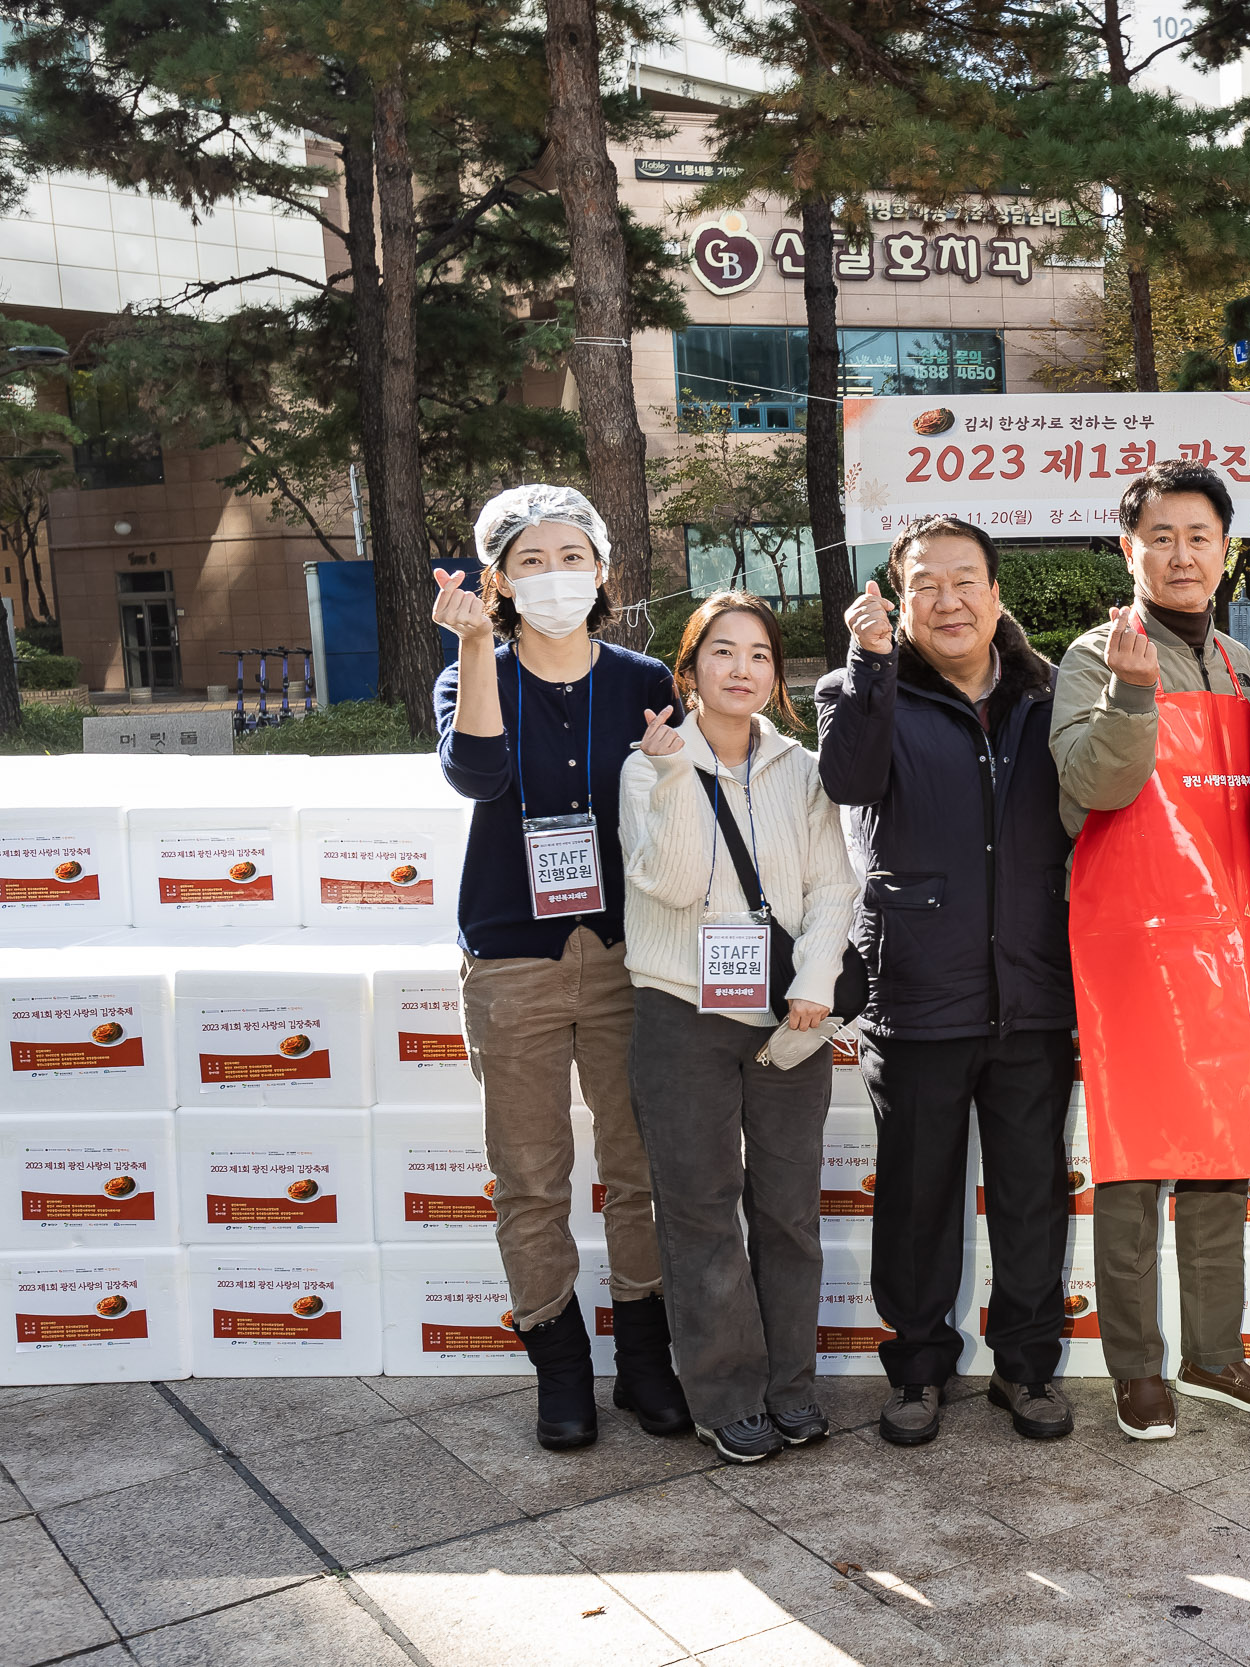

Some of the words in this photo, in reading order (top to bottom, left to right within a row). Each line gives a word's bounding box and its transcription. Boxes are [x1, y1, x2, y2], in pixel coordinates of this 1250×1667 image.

[956, 350, 981, 364] 문의
[915, 365, 948, 379] 1688
[957, 367, 995, 380] 4650
[964, 416, 993, 432] 김치
[999, 415, 1064, 431] 한상자로
[1069, 415, 1117, 430] 전하는
[1123, 415, 1155, 430] 안부
[905, 444, 1026, 483] 2023
[1040, 439, 1156, 483] 제1회
[880, 515, 892, 531] 일
[897, 513, 909, 527] 시
[967, 512, 987, 525] 11.
[991, 509, 1033, 525] 20(월)
[1050, 509, 1064, 524] 장
[1068, 510, 1083, 522] 소
[120, 731, 198, 747] 머릿돌
[1182, 775, 1202, 787] 광진
[1203, 775, 1227, 786] 사랑의
[3, 850, 20, 858] 제1회
[23, 849, 36, 858] 광진
[39, 848, 60, 857] 사랑의
[63, 847, 91, 856] 김장축제
[197, 850, 211, 858] 광진
[213, 849, 234, 857] 사랑의
[236, 849, 264, 857] 김장축제
[539, 850, 588, 868] STAFF
[538, 865, 592, 883] 진행요원
[548, 892, 588, 903] 광진복지재단
[711, 946, 760, 959] STAFF
[708, 961, 761, 975] 진행요원
[715, 988, 754, 996] 광진복지재단
[402, 1002, 419, 1011] 2023
[421, 1002, 440, 1011] 제1회
[443, 1001, 459, 1010] 광진
[31, 1011, 52, 1019] 제1회
[54, 1009, 71, 1019] 광진
[73, 1009, 98, 1018] 사랑의
[100, 1007, 133, 1017] 김장축제
[221, 1023, 241, 1031] 제1회
[243, 1022, 259, 1031] 광진
[262, 1021, 286, 1030] 사랑의
[288, 1020, 320, 1029] 김장축제
[44, 1162, 65, 1170] 제1회
[67, 1161, 84, 1170] 광진
[86, 1161, 111, 1170] 사랑의
[113, 1162, 146, 1170] 김장축제
[230, 1165, 250, 1173] 제1회
[252, 1165, 268, 1174] 광진
[271, 1165, 295, 1174] 사랑의
[297, 1165, 329, 1174] 김장축제
[408, 1163, 425, 1172] 2023
[427, 1163, 447, 1172] 제1회
[449, 1163, 464, 1173] 광진
[38, 1283, 58, 1291] 제1회
[60, 1282, 76, 1291] 광진
[79, 1282, 103, 1290] 사랑의
[105, 1280, 137, 1290] 김장축제
[236, 1281, 256, 1289] 제1회
[258, 1281, 274, 1289] 광진
[276, 1281, 300, 1290] 사랑의
[302, 1281, 334, 1290] 김장축제
[426, 1295, 443, 1303] 2023
[444, 1294, 463, 1303] 제1회
[466, 1294, 482, 1304] 광진
[484, 1294, 508, 1304] 사랑의
